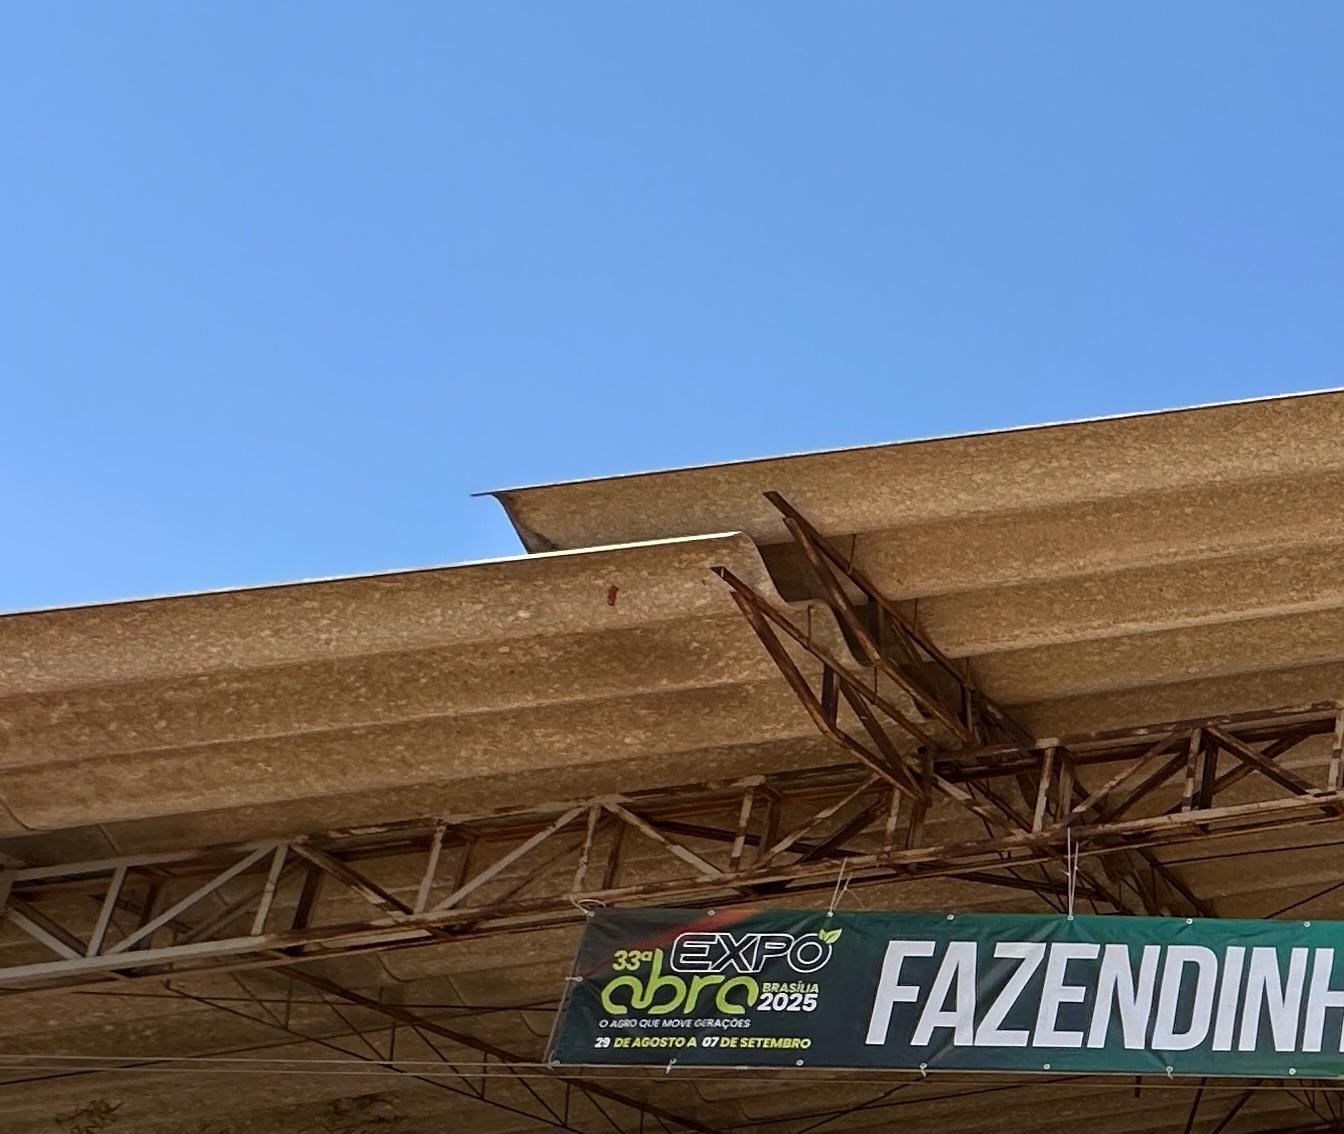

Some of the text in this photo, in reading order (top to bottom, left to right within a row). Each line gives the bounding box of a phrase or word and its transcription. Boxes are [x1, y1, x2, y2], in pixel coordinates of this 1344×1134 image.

[670, 932, 832, 973] EXPO
[762, 980, 819, 994] BRASÍLIA
[757, 993, 818, 1012] 2025
[599, 1017, 751, 1031] O AGRO QUE MOVE GERAÇÕES
[594, 1036, 812, 1049] 29 DE AGOSTO A 07 DE SETEMBRO
